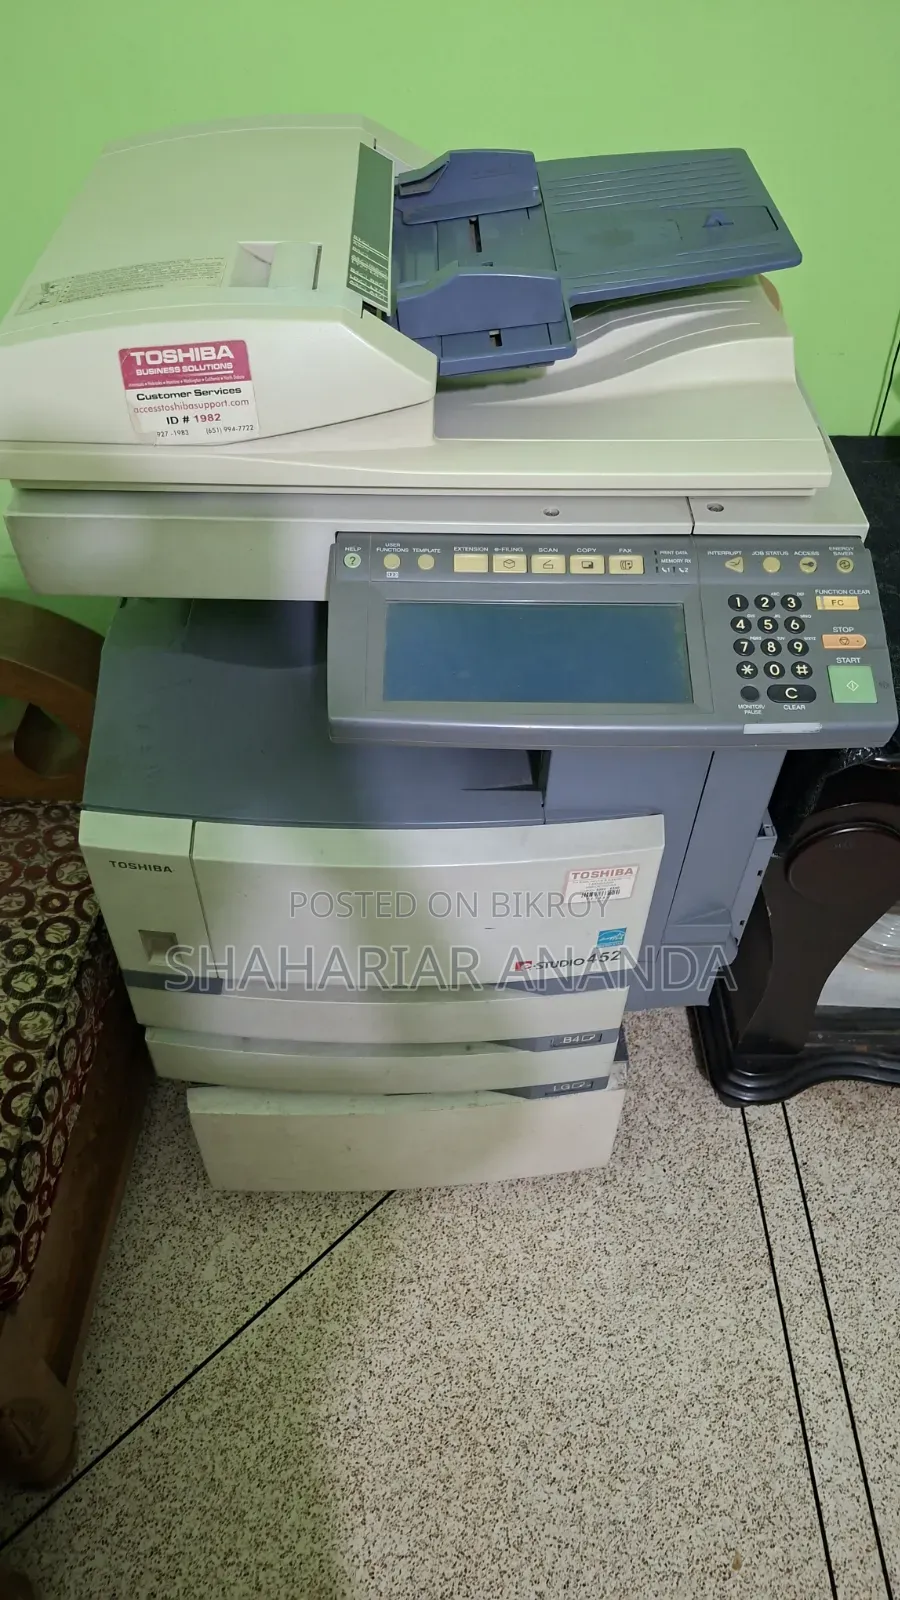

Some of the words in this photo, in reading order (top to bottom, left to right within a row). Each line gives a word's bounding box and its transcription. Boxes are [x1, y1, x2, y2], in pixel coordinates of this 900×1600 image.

[130, 345, 234, 365] TOSHIBA
[136, 365, 180, 376] BUSINESS
[182, 362, 233, 372] SOLUTIONS
[136, 391, 192, 401] Customer
[193, 387, 242, 397] Services
[133, 399, 249, 414] accesstoshibasupport.com
[166, 416, 179, 425] ID
[182, 415, 190, 424] #
[194, 413, 222, 423] 1982
[223, 424, 254, 433] 994-7722
[735, 597, 741, 608] 1
[760, 597, 770, 608] 2
[787, 597, 796, 608] 3
[736, 619, 746, 630] 4
[763, 619, 773, 630] 5
[790, 619, 800, 630] 6
[740, 641, 749, 653] 7
[767, 641, 776, 653] 8
[793, 641, 803, 653] 9
[769, 664, 780, 676] 0
[785, 687, 798, 699] C
[109, 860, 173, 873] TOSHIBA
[572, 867, 634, 879] TOSHIBA
[563, 1035, 580, 1044] B4
